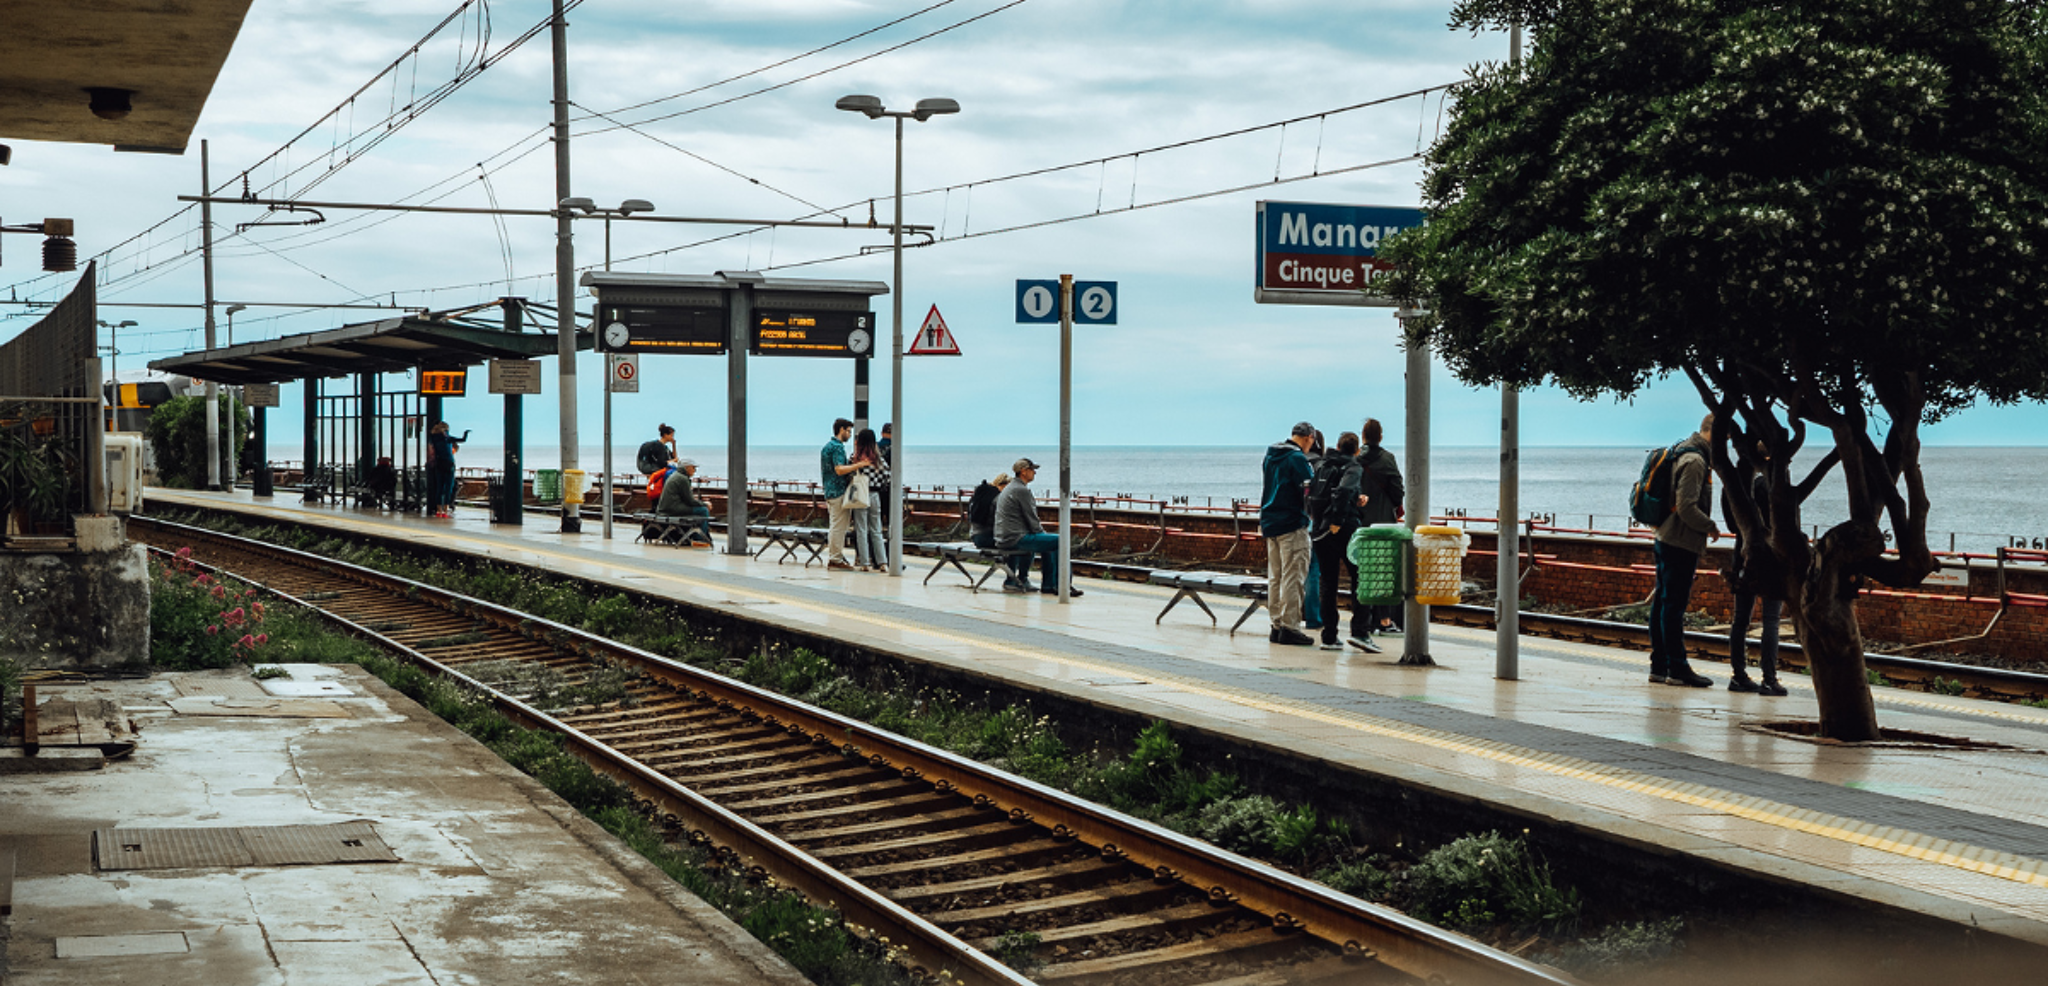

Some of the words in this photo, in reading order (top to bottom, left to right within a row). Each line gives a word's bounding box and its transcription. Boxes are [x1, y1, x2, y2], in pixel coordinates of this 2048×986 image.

[1278, 212, 1430, 249] Manar
[1279, 259, 1354, 288] Cinque
[1033, 292, 1042, 311] 1
[1089, 293, 1103, 313] 2
[612, 308, 618, 320] 1
[857, 316, 866, 328] 2
